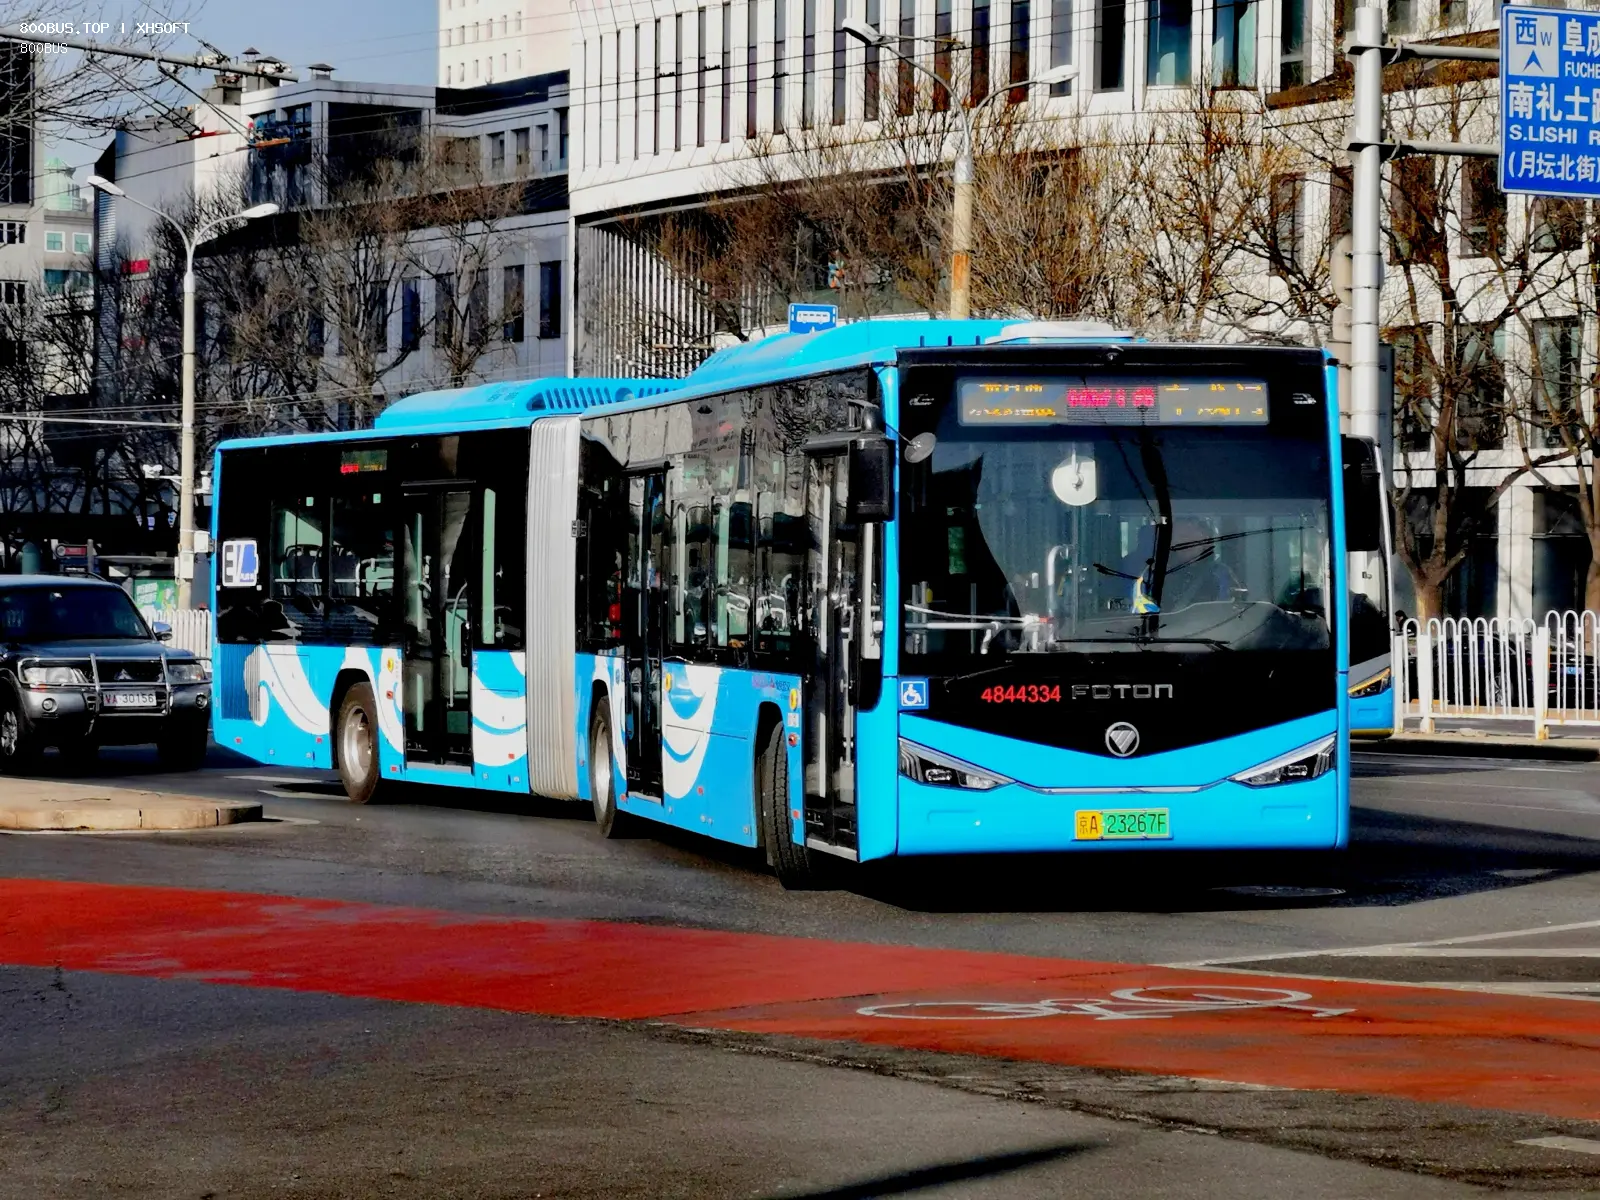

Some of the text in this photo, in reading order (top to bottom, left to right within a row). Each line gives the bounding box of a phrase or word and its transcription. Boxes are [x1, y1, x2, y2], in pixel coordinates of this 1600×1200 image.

[1515, 16, 1538, 46] 西
[1540, 31, 1553, 47] W
[1509, 124, 1578, 145] S.LISHI
[122, 693, 154, 704] 30156
[981, 684, 1062, 703] 4844334
[1071, 684, 1174, 700] FOTON
[1107, 813, 1167, 834] 23267F
